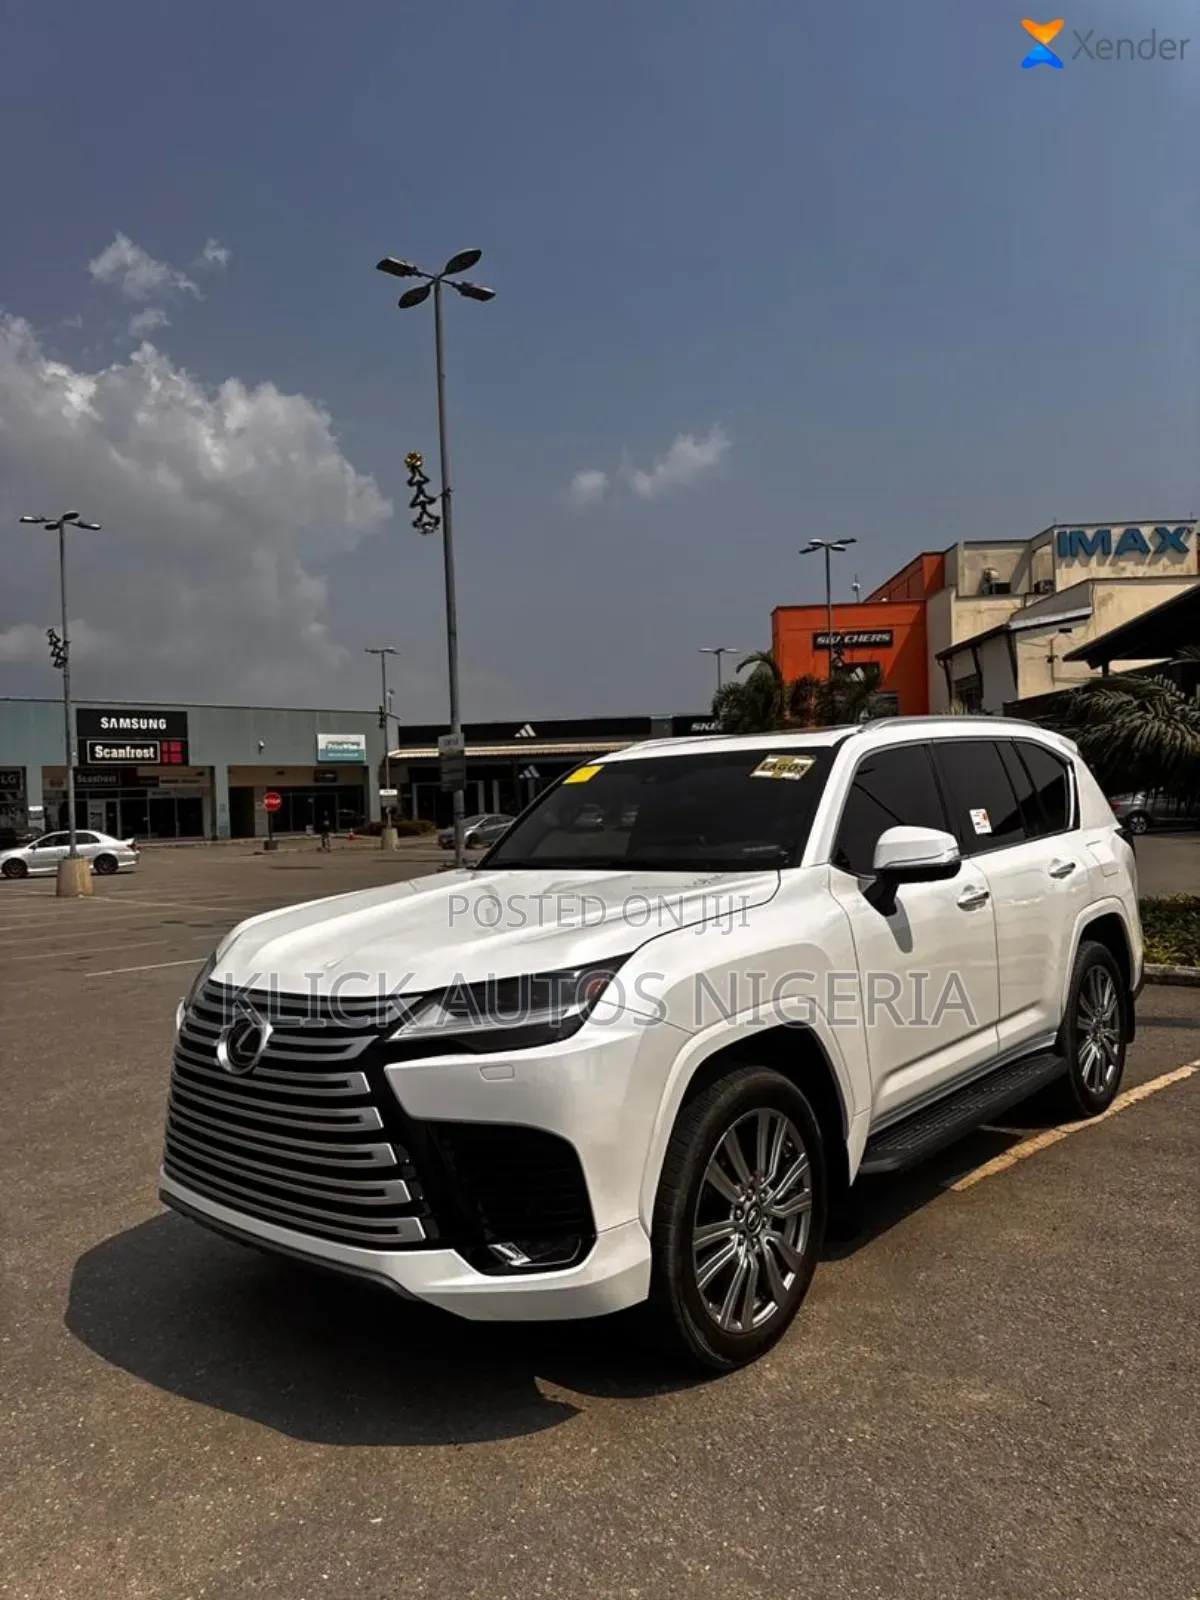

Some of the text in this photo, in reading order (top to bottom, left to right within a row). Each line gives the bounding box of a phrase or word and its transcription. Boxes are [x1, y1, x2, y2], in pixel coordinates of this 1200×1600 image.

[1056, 527, 1191, 558] IMAX
[100, 716, 167, 730] SAMSUNG
[94, 744, 155, 759] Scanfrost
